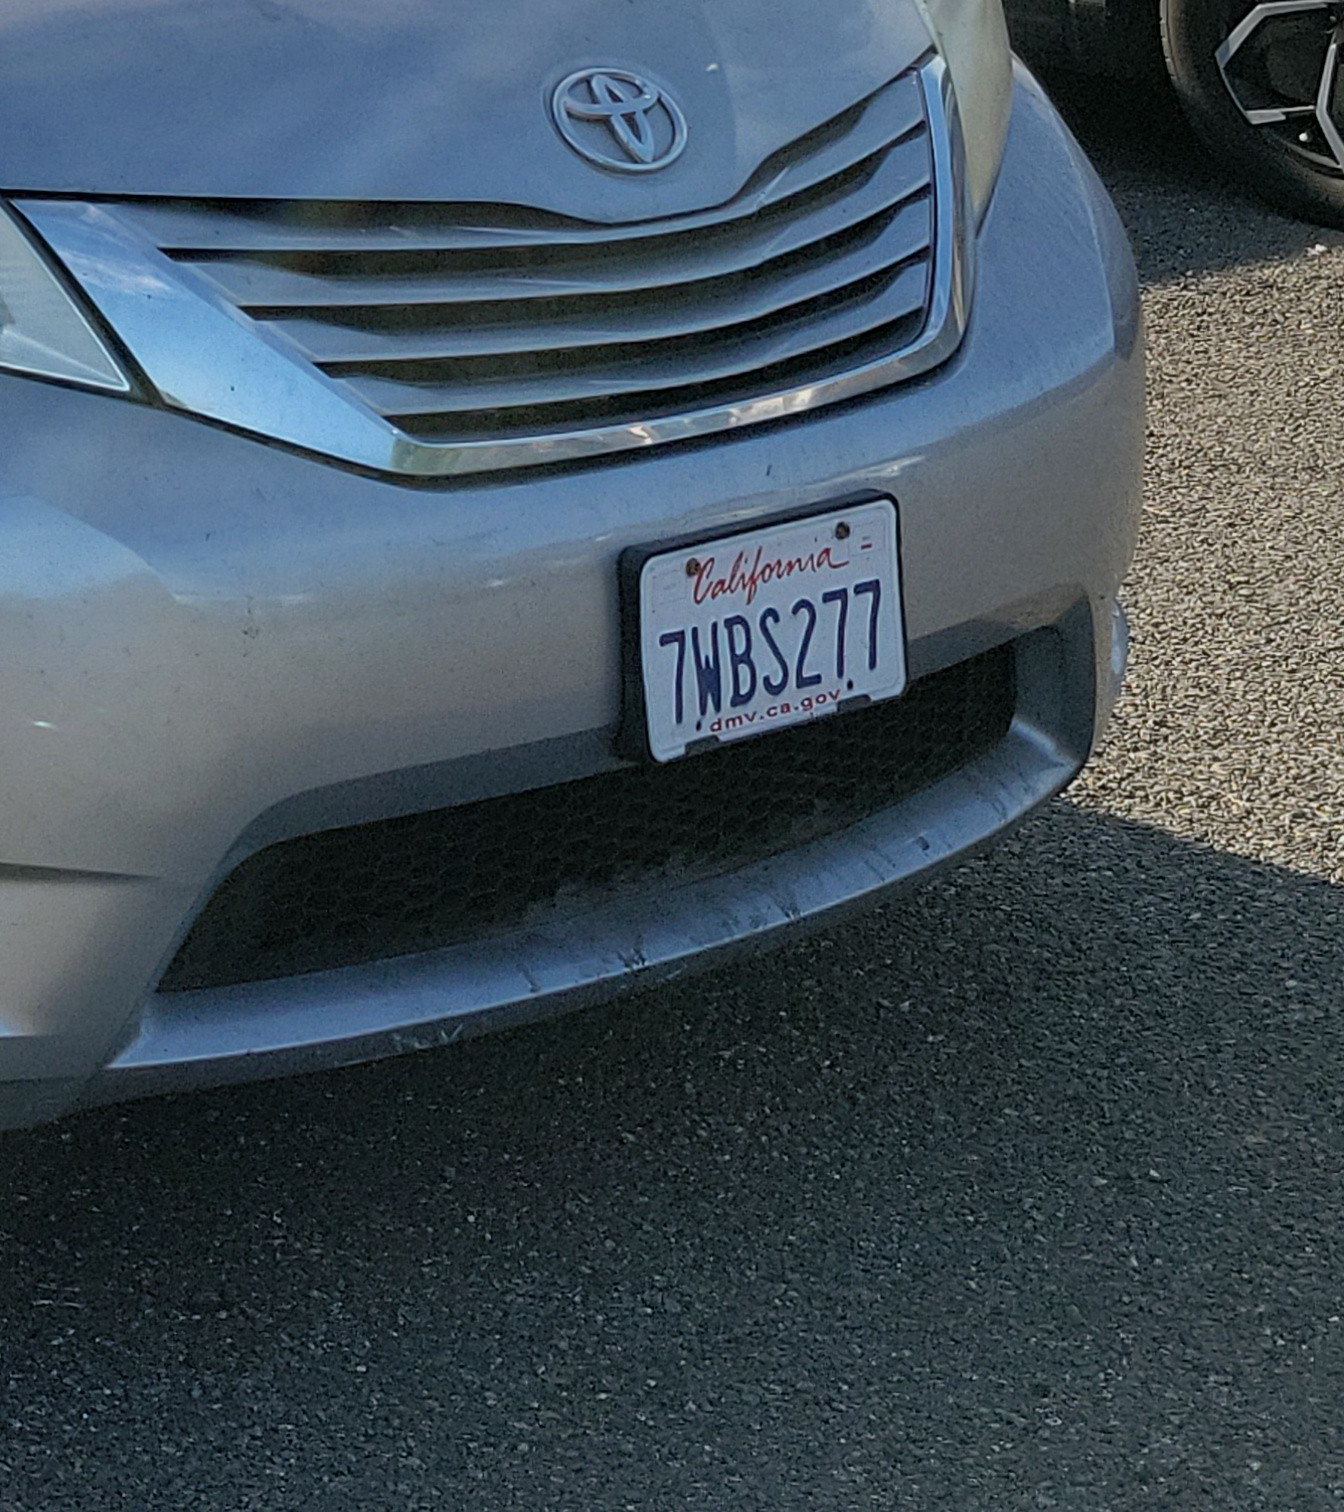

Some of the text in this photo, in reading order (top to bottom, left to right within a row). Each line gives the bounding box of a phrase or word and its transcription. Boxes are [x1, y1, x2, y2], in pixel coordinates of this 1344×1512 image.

[692, 546, 849, 605] California
[659, 579, 882, 724] 7WBS277
[710, 689, 842, 733] dmv.ca.gov
